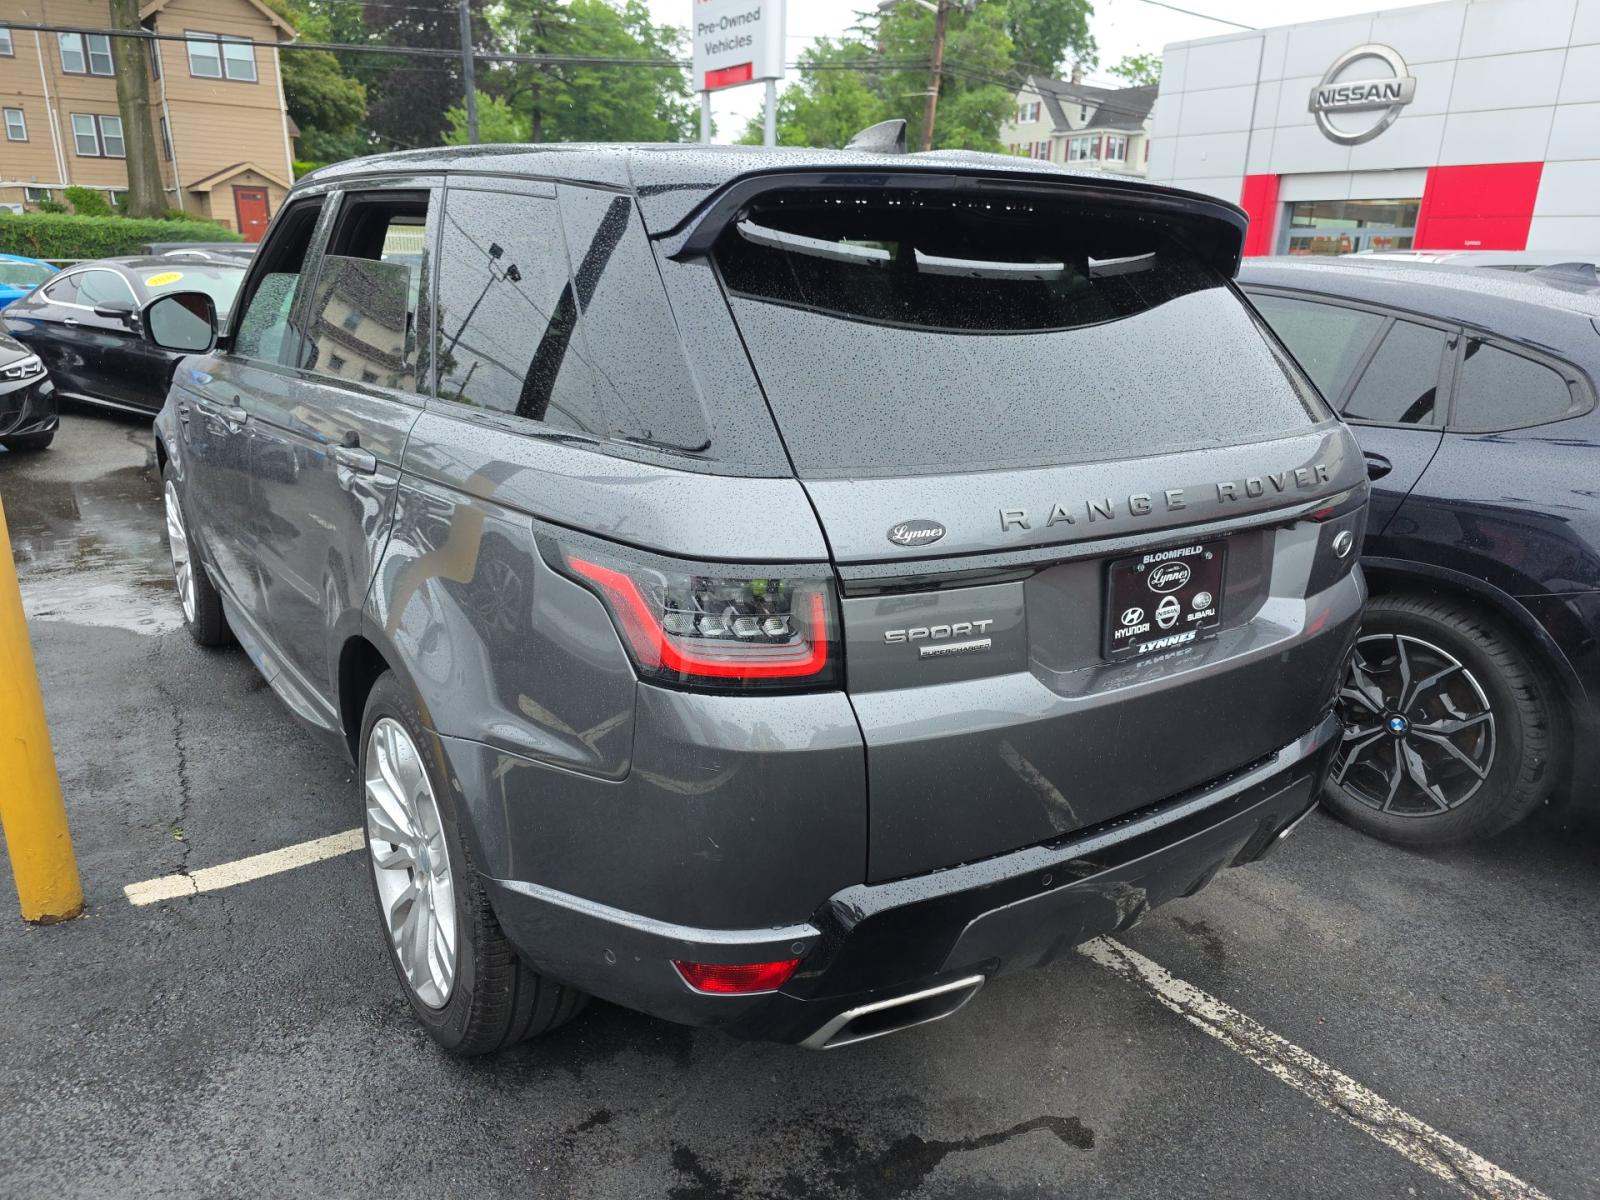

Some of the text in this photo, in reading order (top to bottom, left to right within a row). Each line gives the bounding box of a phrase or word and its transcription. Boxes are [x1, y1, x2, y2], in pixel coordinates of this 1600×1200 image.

[698, 7, 761, 36] Pre-Owned
[705, 34, 753, 55] Vehicles
[1317, 83, 1402, 106] NISSAN
[999, 463, 1331, 533] RANGE ROVER
[893, 525, 942, 543] Lynnes
[1143, 545, 1203, 564] BLOOMFIELD
[1151, 568, 1188, 587] Lynnes
[1158, 608, 1178, 618] NISSAN
[1187, 608, 1216, 621] SUBARU
[884, 619, 993, 645] SPORT
[1115, 622, 1151, 639] HYUNDAI
[1139, 631, 1197, 653] LYNNES
